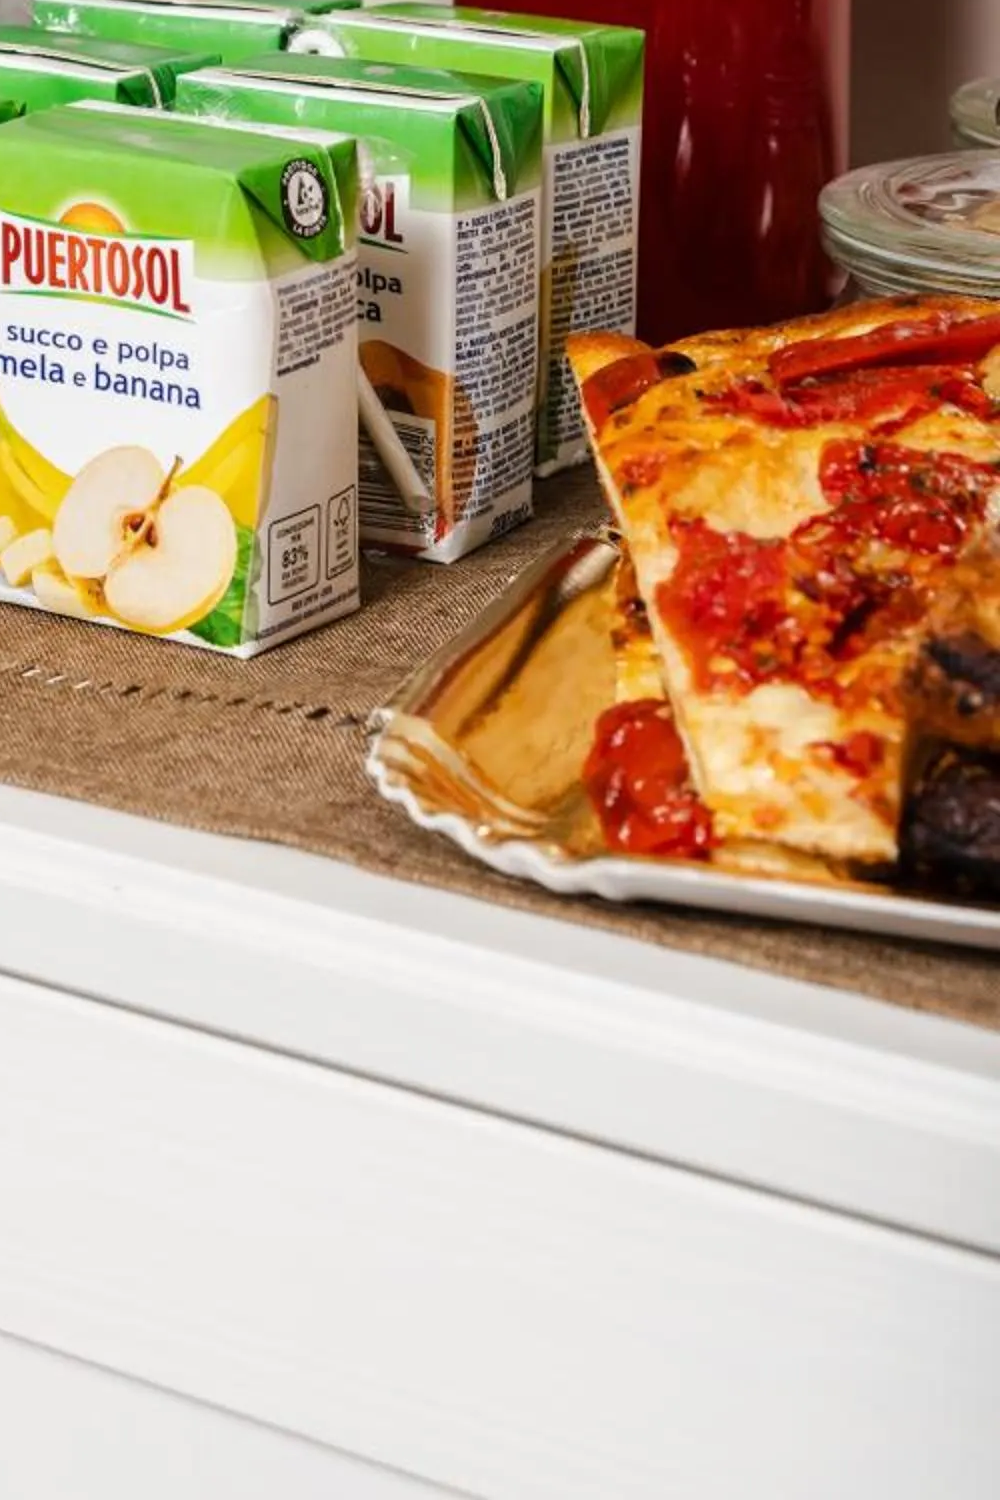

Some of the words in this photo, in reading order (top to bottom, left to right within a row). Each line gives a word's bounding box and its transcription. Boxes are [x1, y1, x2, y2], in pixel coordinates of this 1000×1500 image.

[2, 221, 190, 313] PUERTOSOL
[7, 324, 83, 351] succo
[92, 338, 108, 355] e
[117, 343, 190, 371] polpa
[73, 371, 87, 387] e
[94, 363, 201, 409] banana
